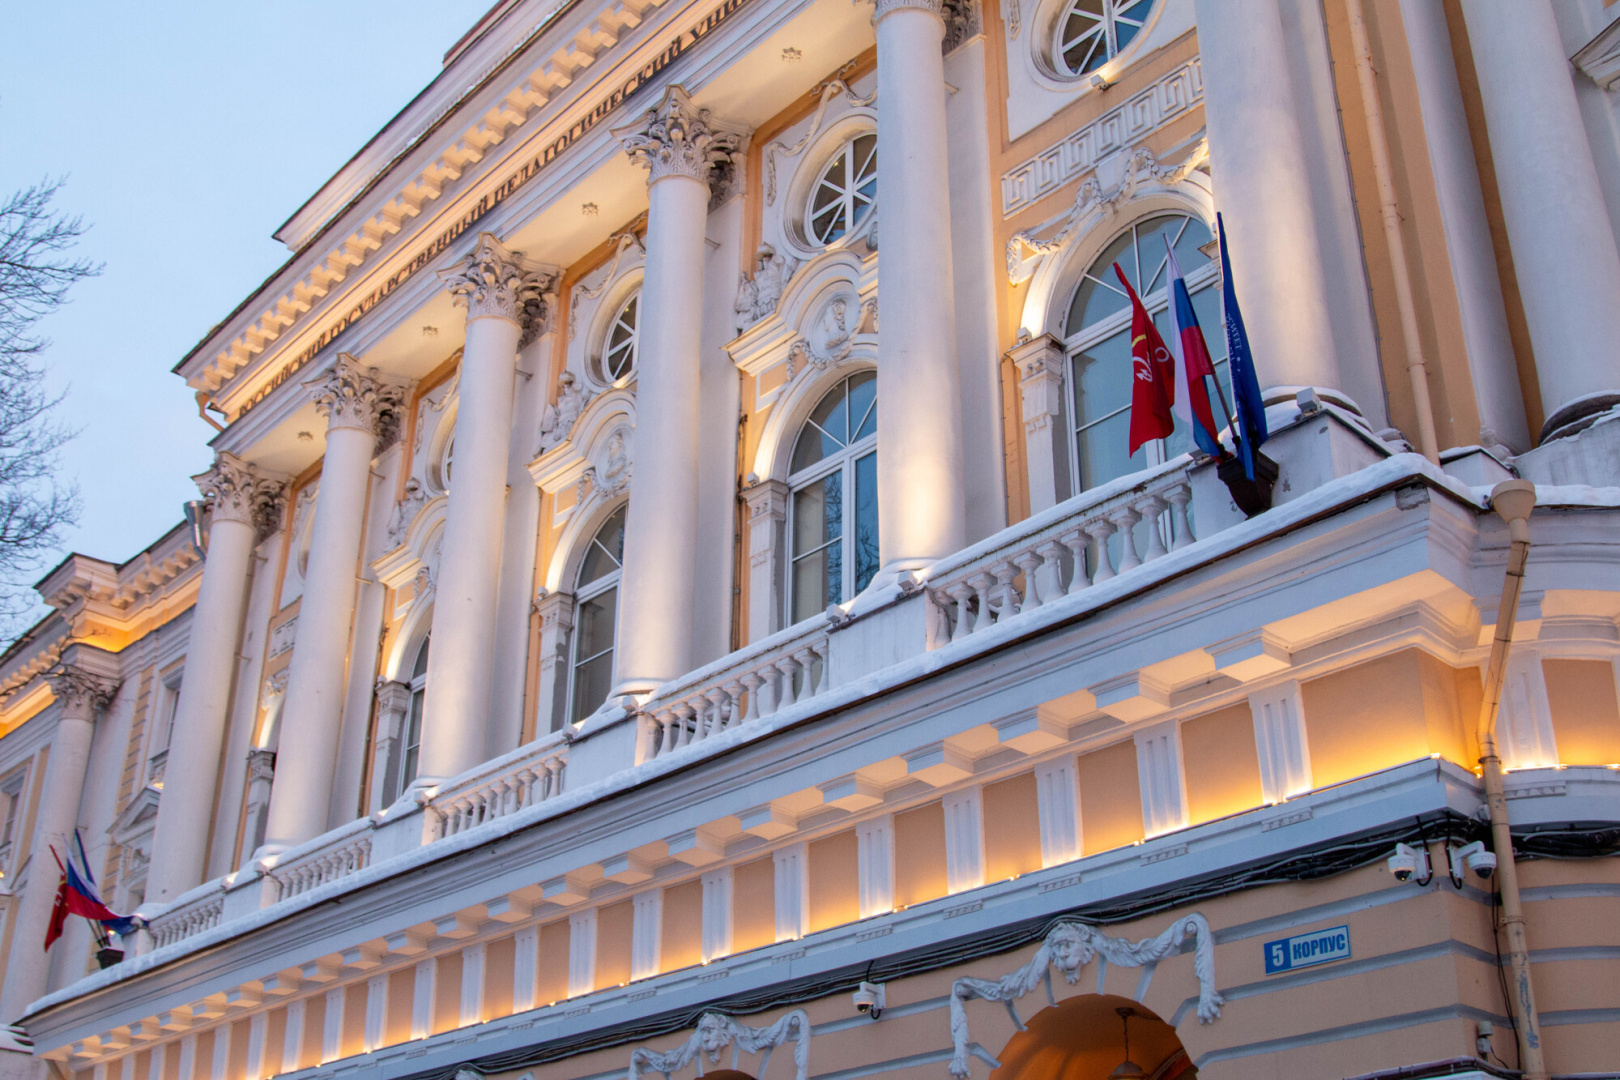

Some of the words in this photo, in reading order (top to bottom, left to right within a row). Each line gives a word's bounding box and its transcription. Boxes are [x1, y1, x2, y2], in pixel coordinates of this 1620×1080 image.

[494, 36, 682, 203] ПЕДАГОГИЧЕСКИЙ
[689, 0, 746, 40] УНИ
[1272, 944, 1284, 966] 5
[1293, 934, 1345, 960] КОРПУС
